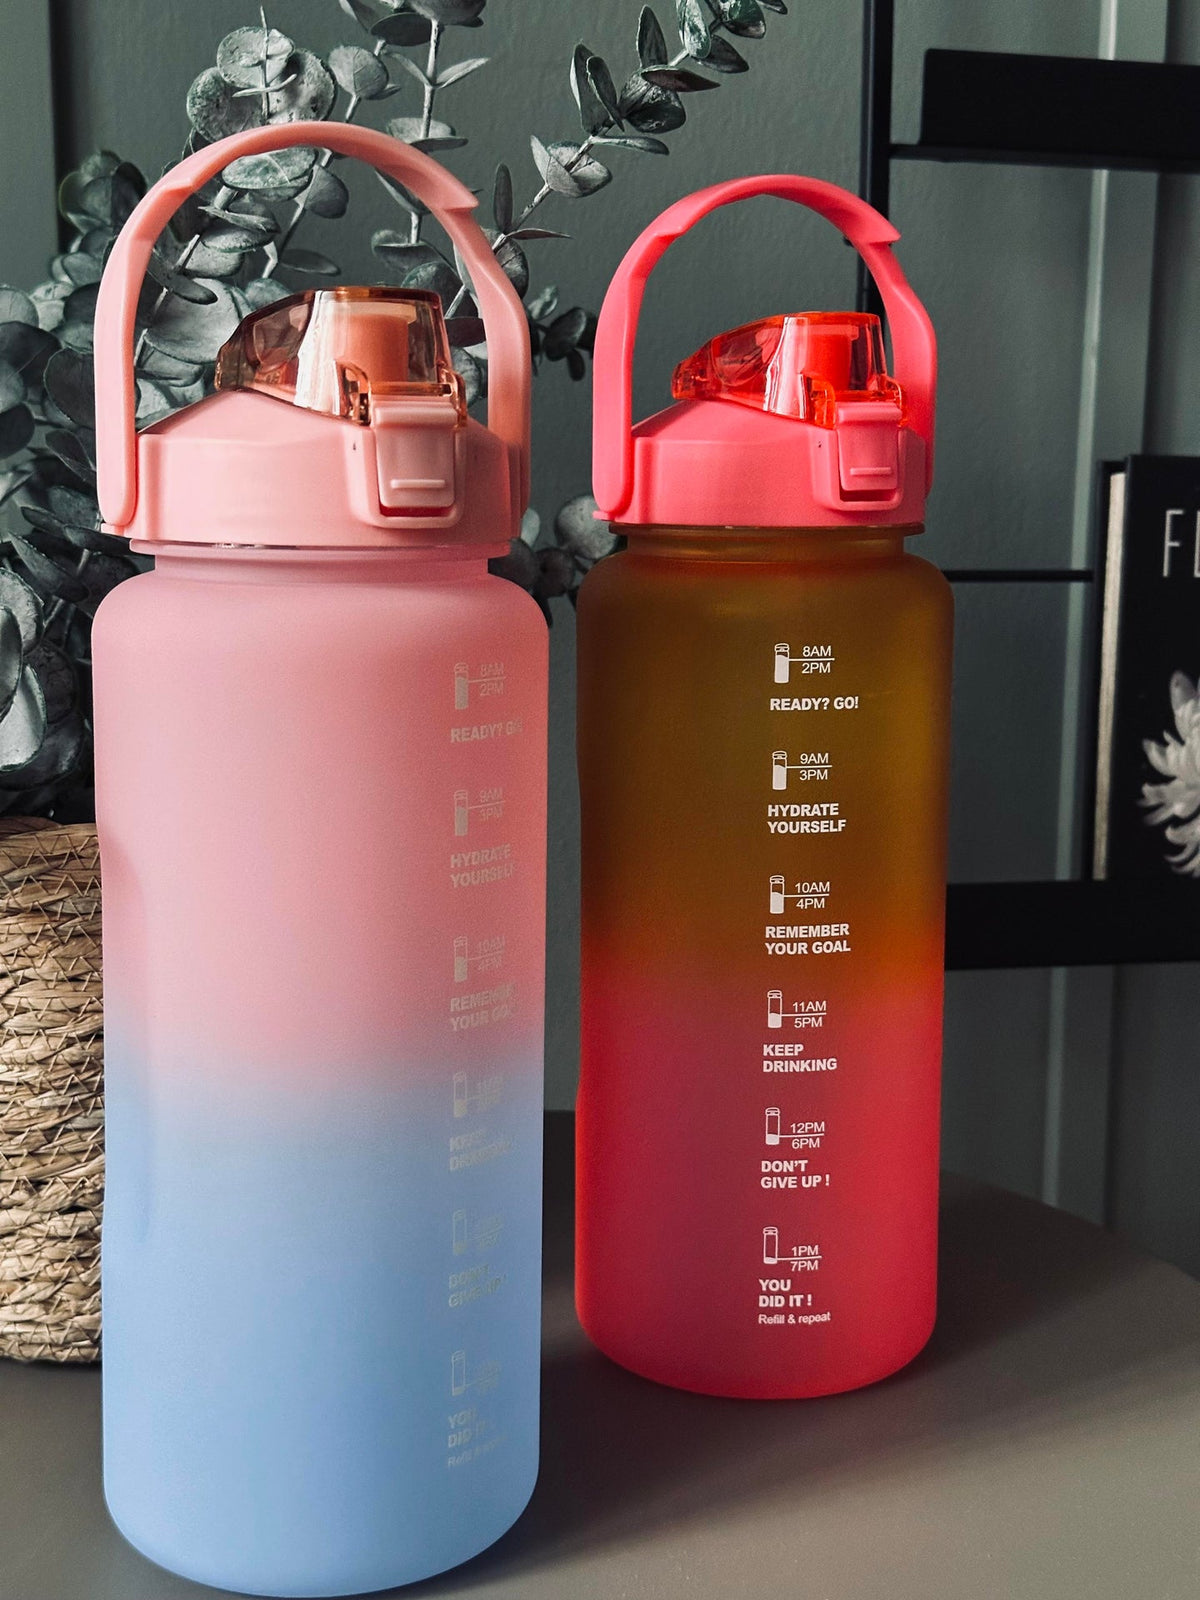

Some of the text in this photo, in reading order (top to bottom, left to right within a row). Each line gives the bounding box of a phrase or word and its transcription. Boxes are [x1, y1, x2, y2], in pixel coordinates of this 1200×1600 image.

[802, 645, 832, 657] 8AM
[801, 662, 831, 674] 2PM
[770, 696, 859, 711] READY? GO!
[799, 752, 829, 765] 9AM
[799, 769, 828, 781] 3PM
[767, 803, 839, 817] HYDRATE
[767, 819, 846, 834] YOURSELF
[794, 881, 830, 894] 10AM
[796, 898, 825, 910] 4PM
[765, 923, 849, 938] REMEMBER
[765, 940, 851, 955] YOUR GOAL
[792, 1000, 827, 1013] 11AM
[794, 1017, 823, 1029] 5PM
[762, 1043, 804, 1057] KEEP
[762, 1057, 838, 1073] DRINKING
[790, 1121, 825, 1134] 12PM
[791, 1137, 820, 1150] 6PM
[760, 1176, 797, 1189] GIVE
[801, 1175, 822, 1188] UP
[791, 1244, 819, 1257] 1PM
[790, 1259, 819, 1272] 7PM
[759, 1279, 791, 1292] YOU
[758, 1295, 785, 1308] DID
[789, 1294, 804, 1307] IT
[758, 1311, 831, 1325] Refill & repeat
